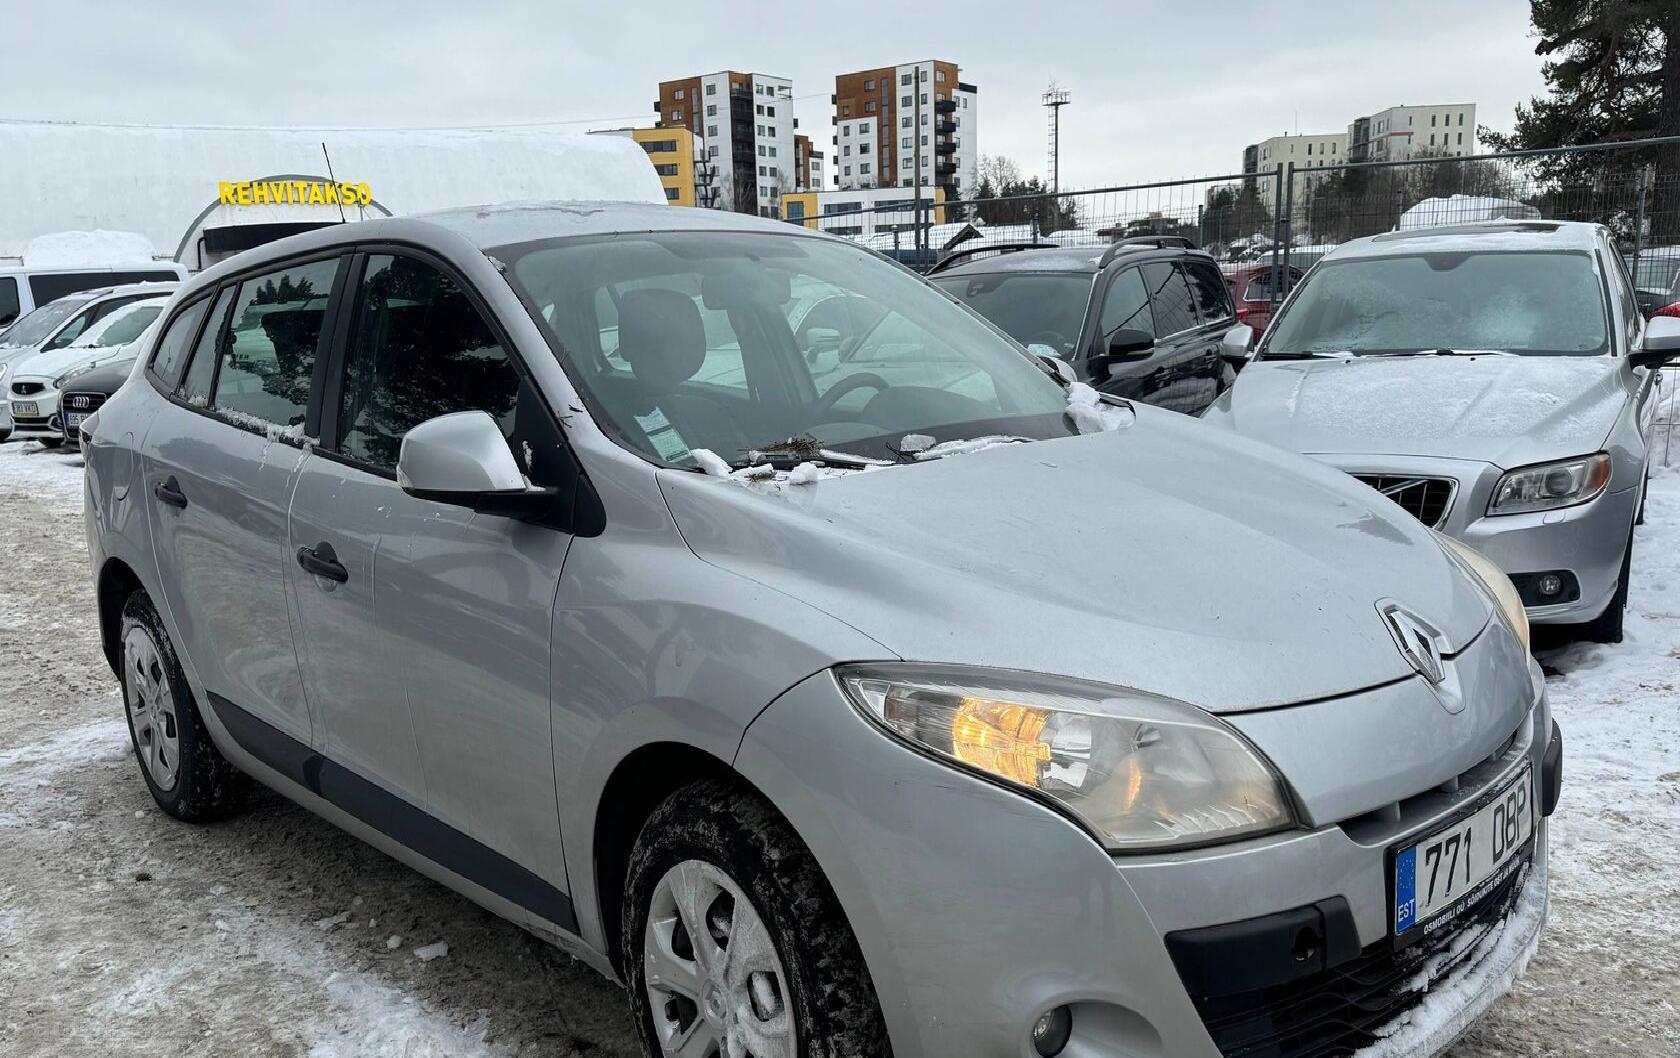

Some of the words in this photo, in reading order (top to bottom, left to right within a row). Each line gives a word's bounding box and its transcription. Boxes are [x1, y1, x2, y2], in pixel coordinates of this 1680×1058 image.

[219, 180, 373, 206] REHVITAKSO
[1425, 826, 1472, 908] 771
[1492, 780, 1527, 866] DBP
[1397, 898, 1416, 923] EST
